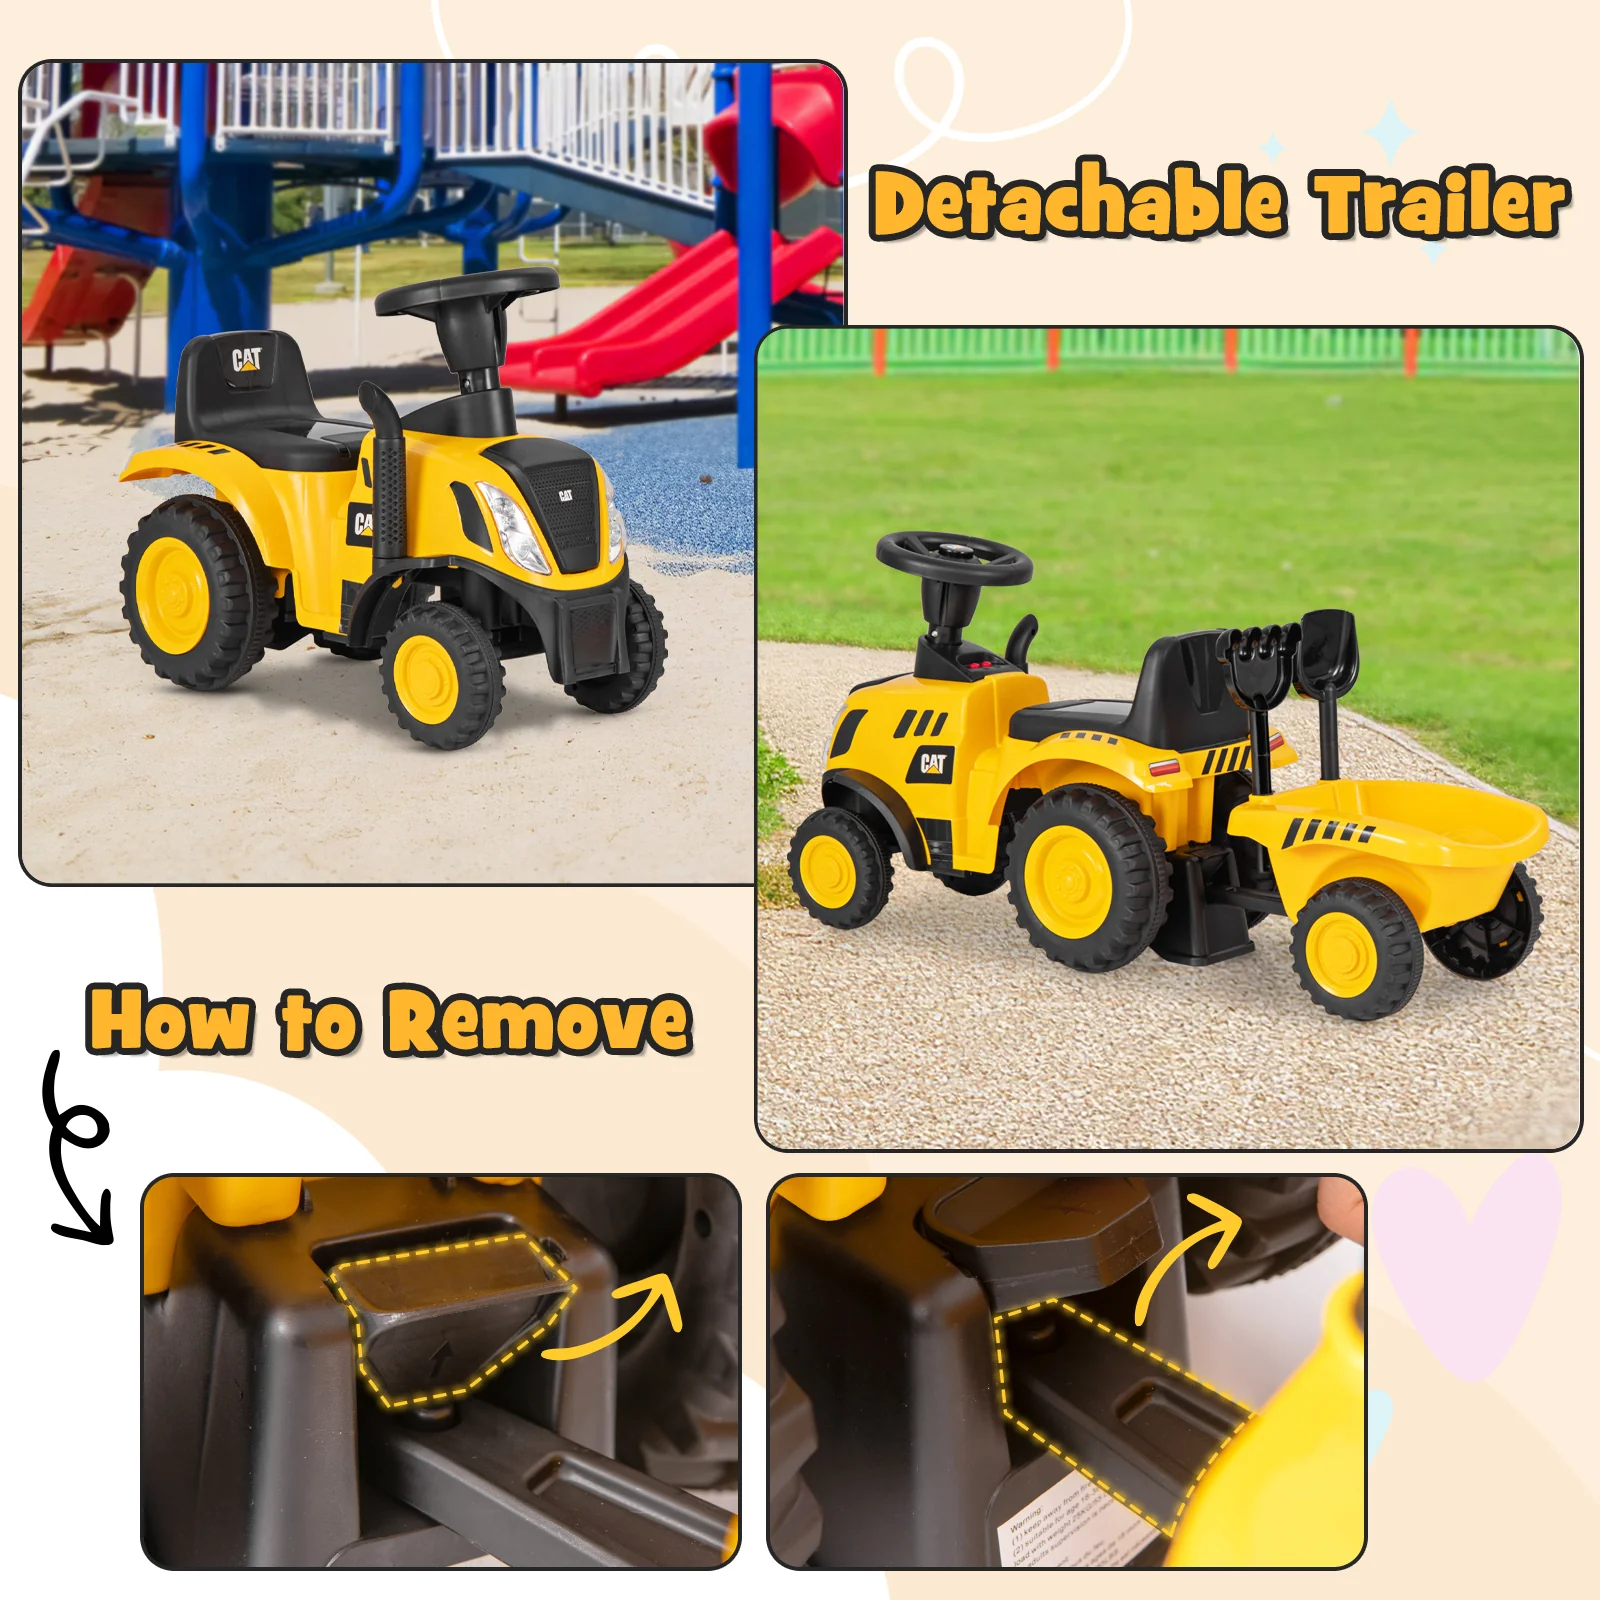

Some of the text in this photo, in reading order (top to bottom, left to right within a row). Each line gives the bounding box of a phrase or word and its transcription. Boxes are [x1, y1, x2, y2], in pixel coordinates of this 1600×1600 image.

[232, 347, 261, 372] CAT
[558, 490, 573, 502] CAT
[921, 753, 946, 774] CAT
[1010, 1505, 1044, 1533] Warning:
[1023, 1519, 1042, 1536] keep
[1043, 1504, 1062, 1521] away
[1063, 1490, 1080, 1506] from
[1024, 1521, 1054, 1547] suitable
[1066, 1502, 1079, 1516] age
[1031, 1539, 1046, 1554] with
[1047, 1520, 1071, 1541] weight
